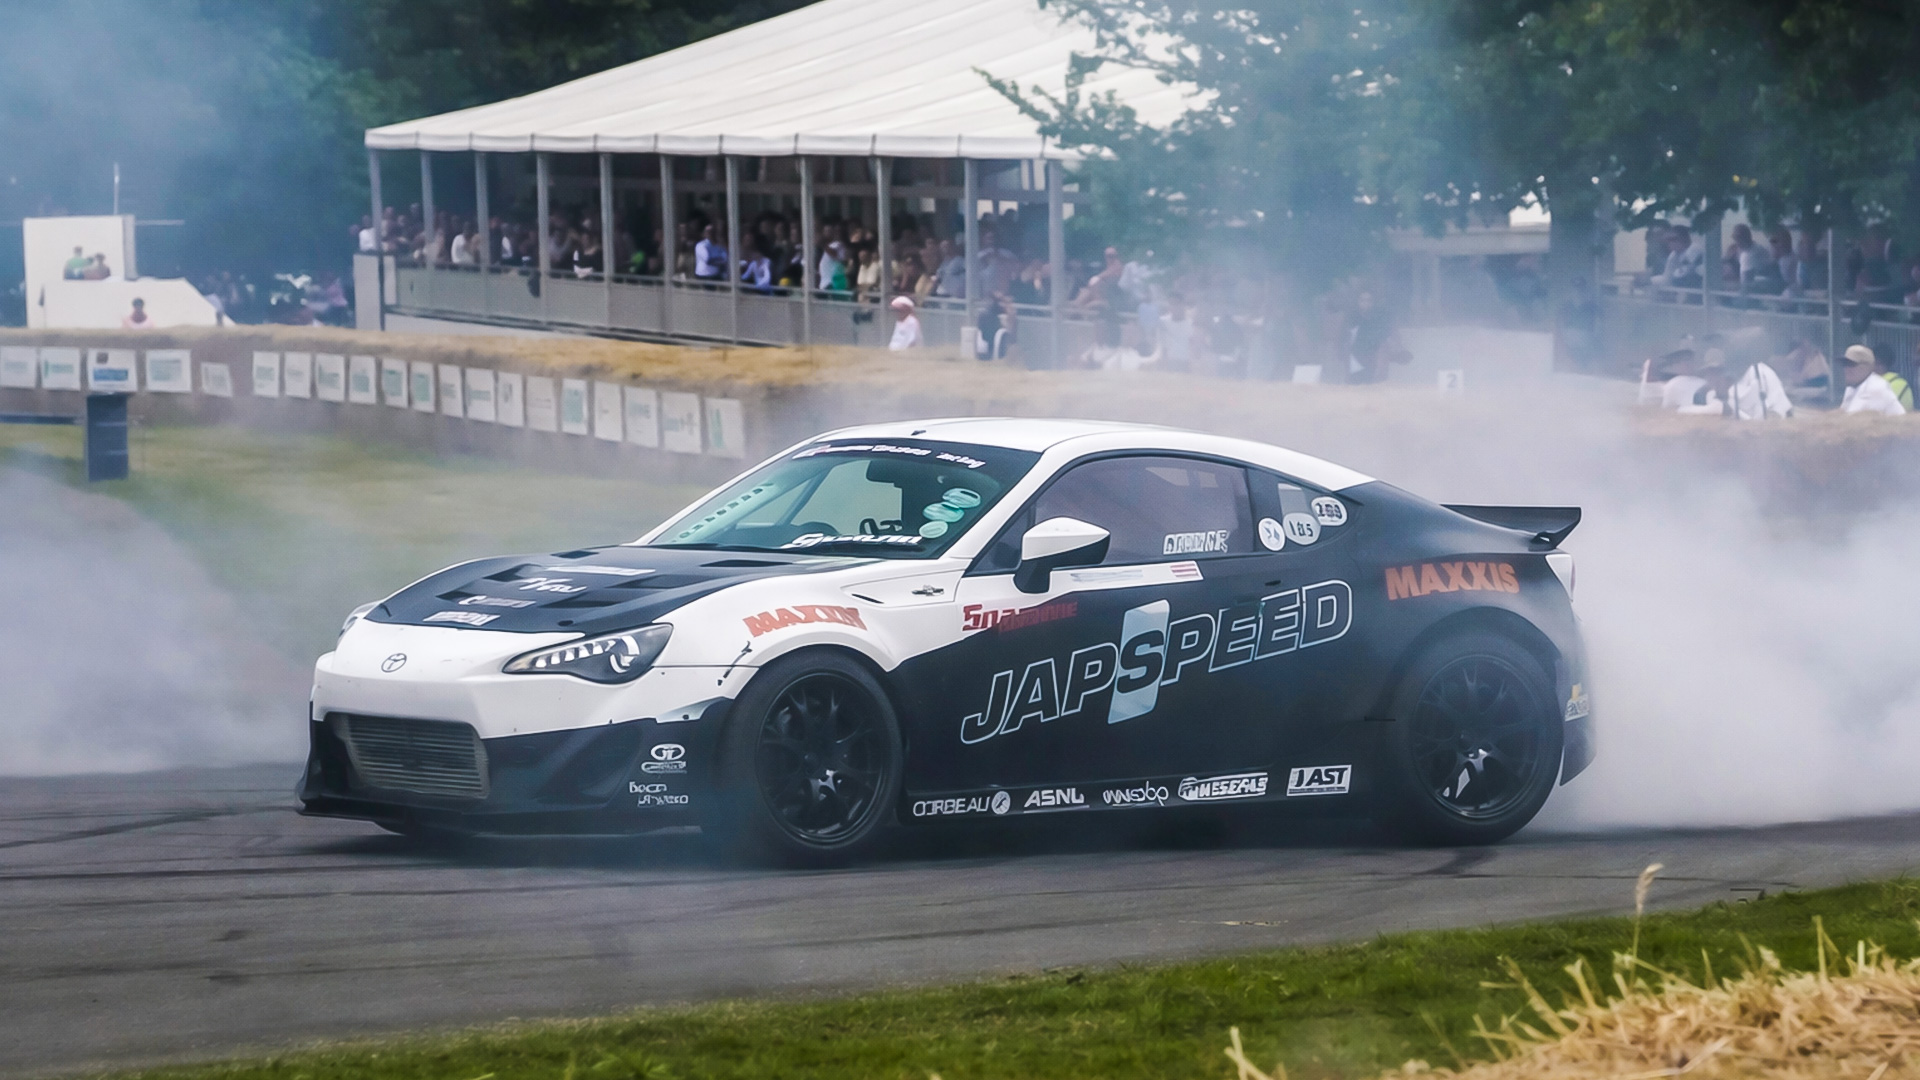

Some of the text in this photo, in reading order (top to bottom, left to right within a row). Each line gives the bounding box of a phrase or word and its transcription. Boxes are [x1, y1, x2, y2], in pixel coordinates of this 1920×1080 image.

[1384, 561, 1520, 601] MAXXIS
[960, 579, 1352, 745] JAPSPEED
[1024, 787, 1085, 808] ASNL
